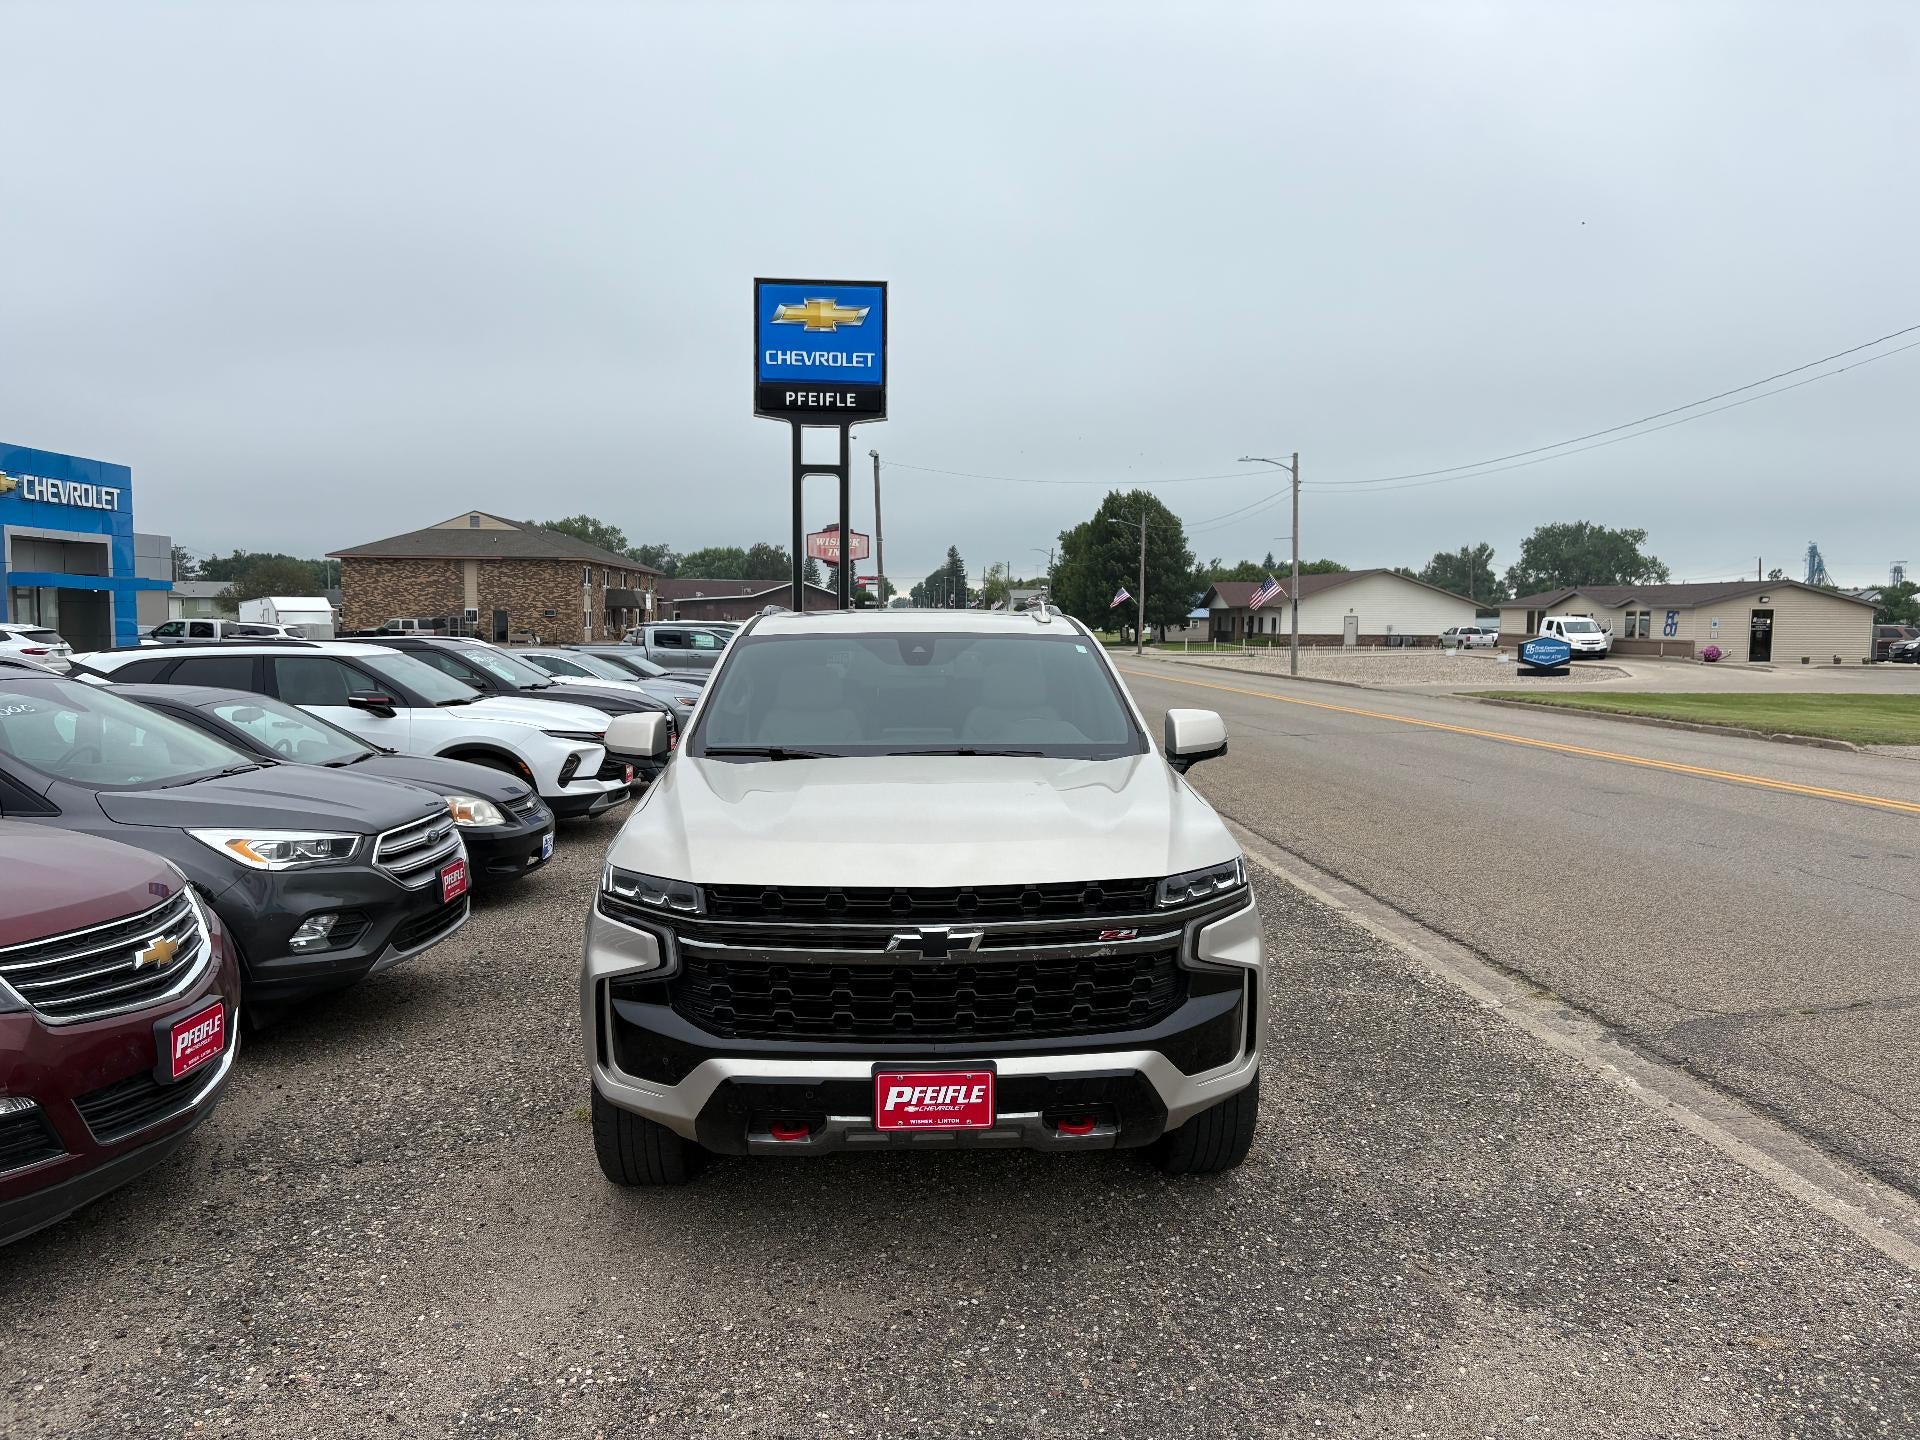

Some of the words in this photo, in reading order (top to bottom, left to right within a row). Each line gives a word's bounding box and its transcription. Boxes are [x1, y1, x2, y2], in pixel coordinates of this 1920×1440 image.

[765, 350, 875, 367] CHEVROLET
[785, 391, 857, 406] PFEIFLE
[22, 475, 120, 511] CHEVROLET
[176, 1014, 221, 1059] PFEIFLE
[884, 1085, 986, 1110] PFEIFLE
